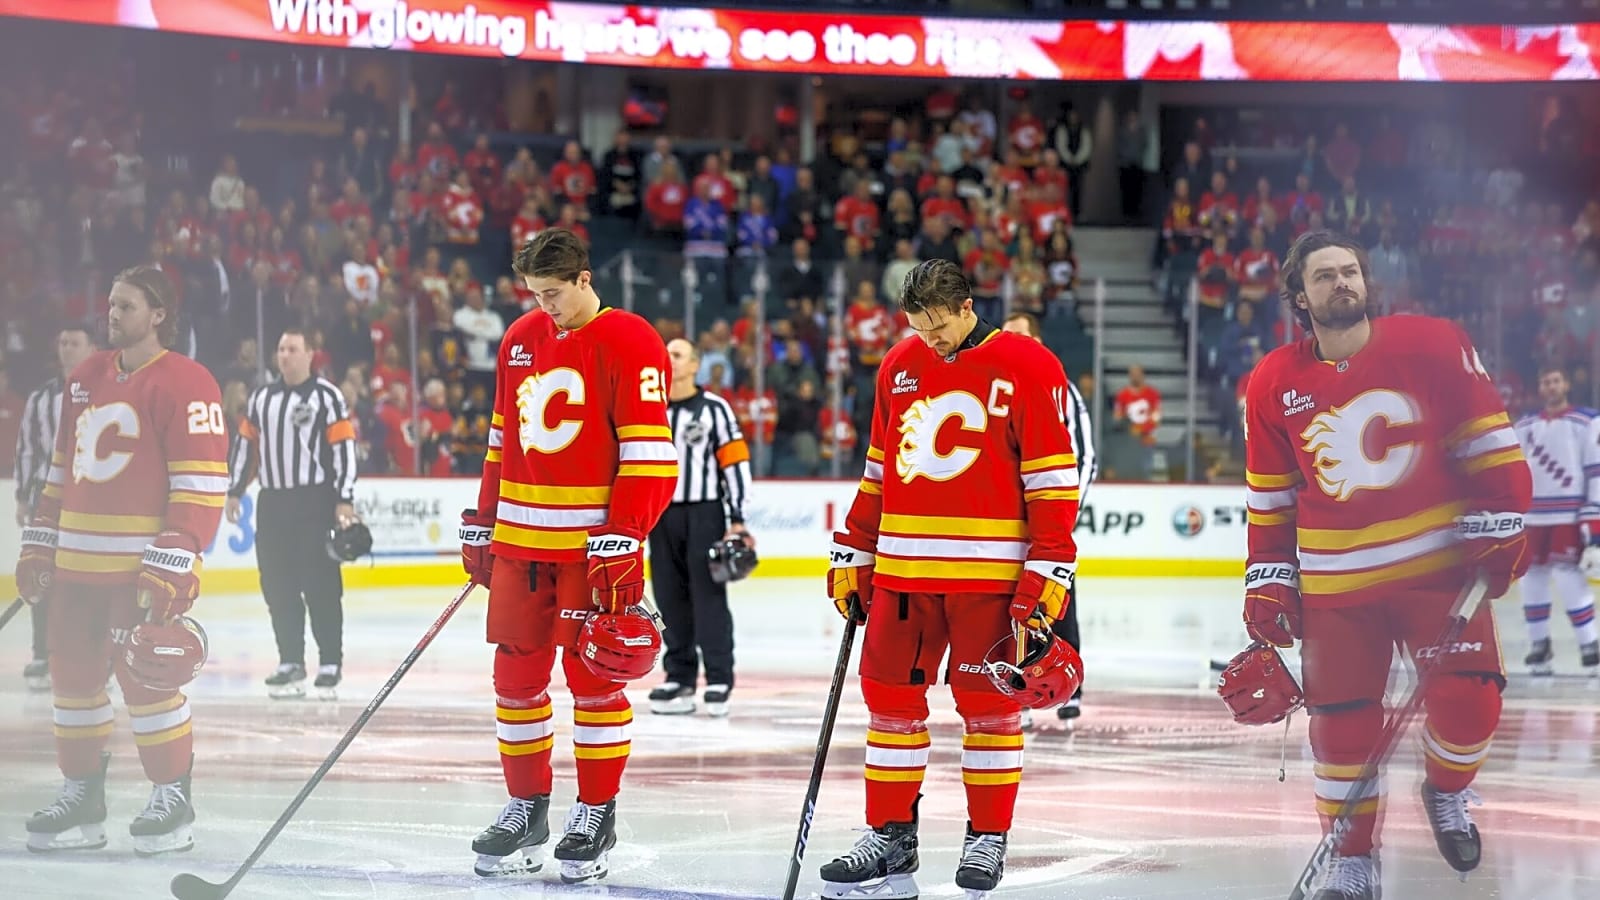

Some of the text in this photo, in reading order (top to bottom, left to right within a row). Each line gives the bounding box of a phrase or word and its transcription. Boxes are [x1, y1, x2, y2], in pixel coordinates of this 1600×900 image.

[269, 0, 357, 36] With
[369, 0, 526, 57] glowing
[536, 11, 661, 56] hearts
[667, 27, 731, 59] we
[740, 28, 816, 63] see
[823, 23, 916, 66] thee
[516, 349, 533, 360] play
[508, 359, 533, 367] alberta
[901, 376, 918, 386] play
[892, 384, 918, 394] alberta
[987, 378, 1014, 418] C
[1293, 394, 1312, 407] play
[1284, 402, 1315, 416] alberta
[187, 401, 224, 435] 20
[1459, 517, 1523, 534] BAUER
